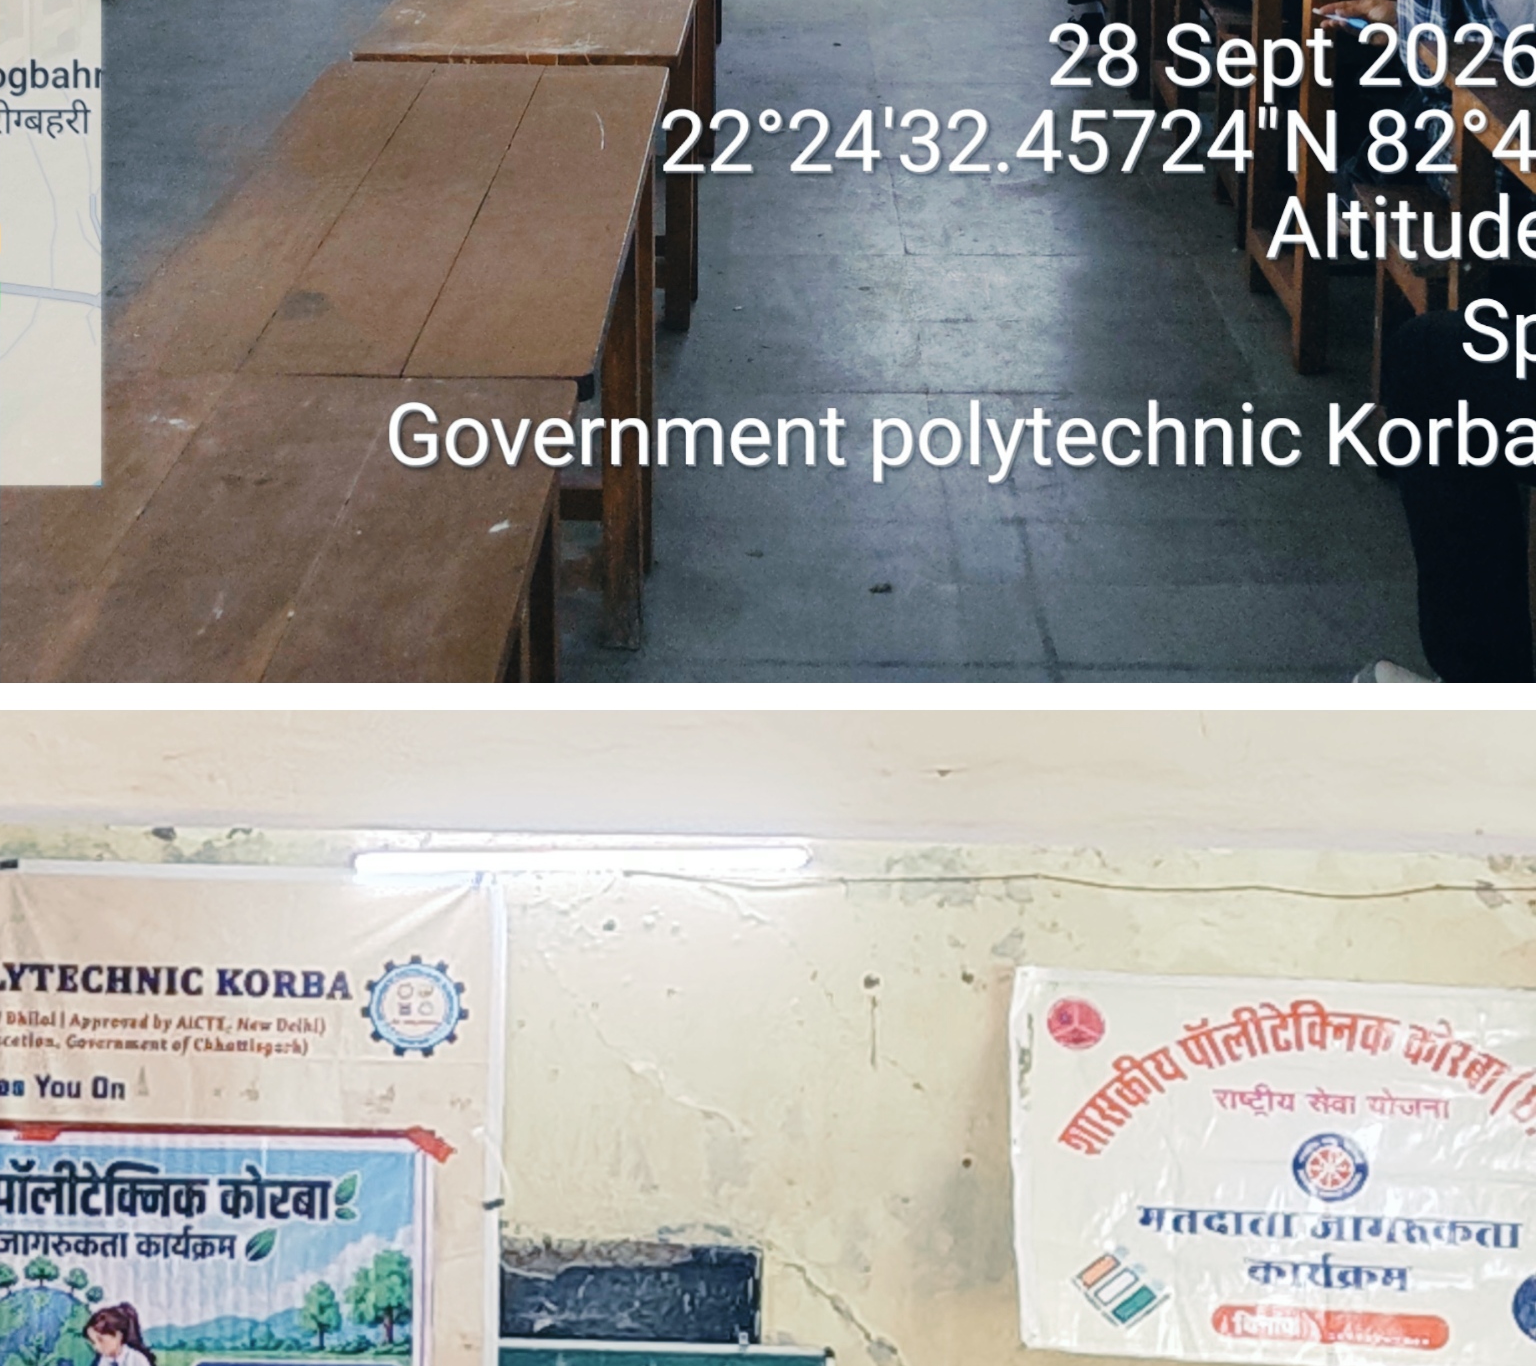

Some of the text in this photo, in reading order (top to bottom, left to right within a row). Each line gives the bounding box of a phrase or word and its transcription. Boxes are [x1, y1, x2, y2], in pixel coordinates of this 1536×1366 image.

[216, 968, 353, 1001] KORBA
[34, 1074, 82, 1099] You
[91, 1075, 125, 1100] On
[1058, 1047, 1187, 1157] शासकीय
[1213, 1083, 1450, 1120] राष्ट्रीय सेवा योजना
[219, 1164, 332, 1220] कोरबा
[1136, 1203, 1294, 1239] मतदाता
[135, 1225, 238, 1261] कार्यक्रम
[1243, 1252, 1413, 1292] कार्यक्रम
